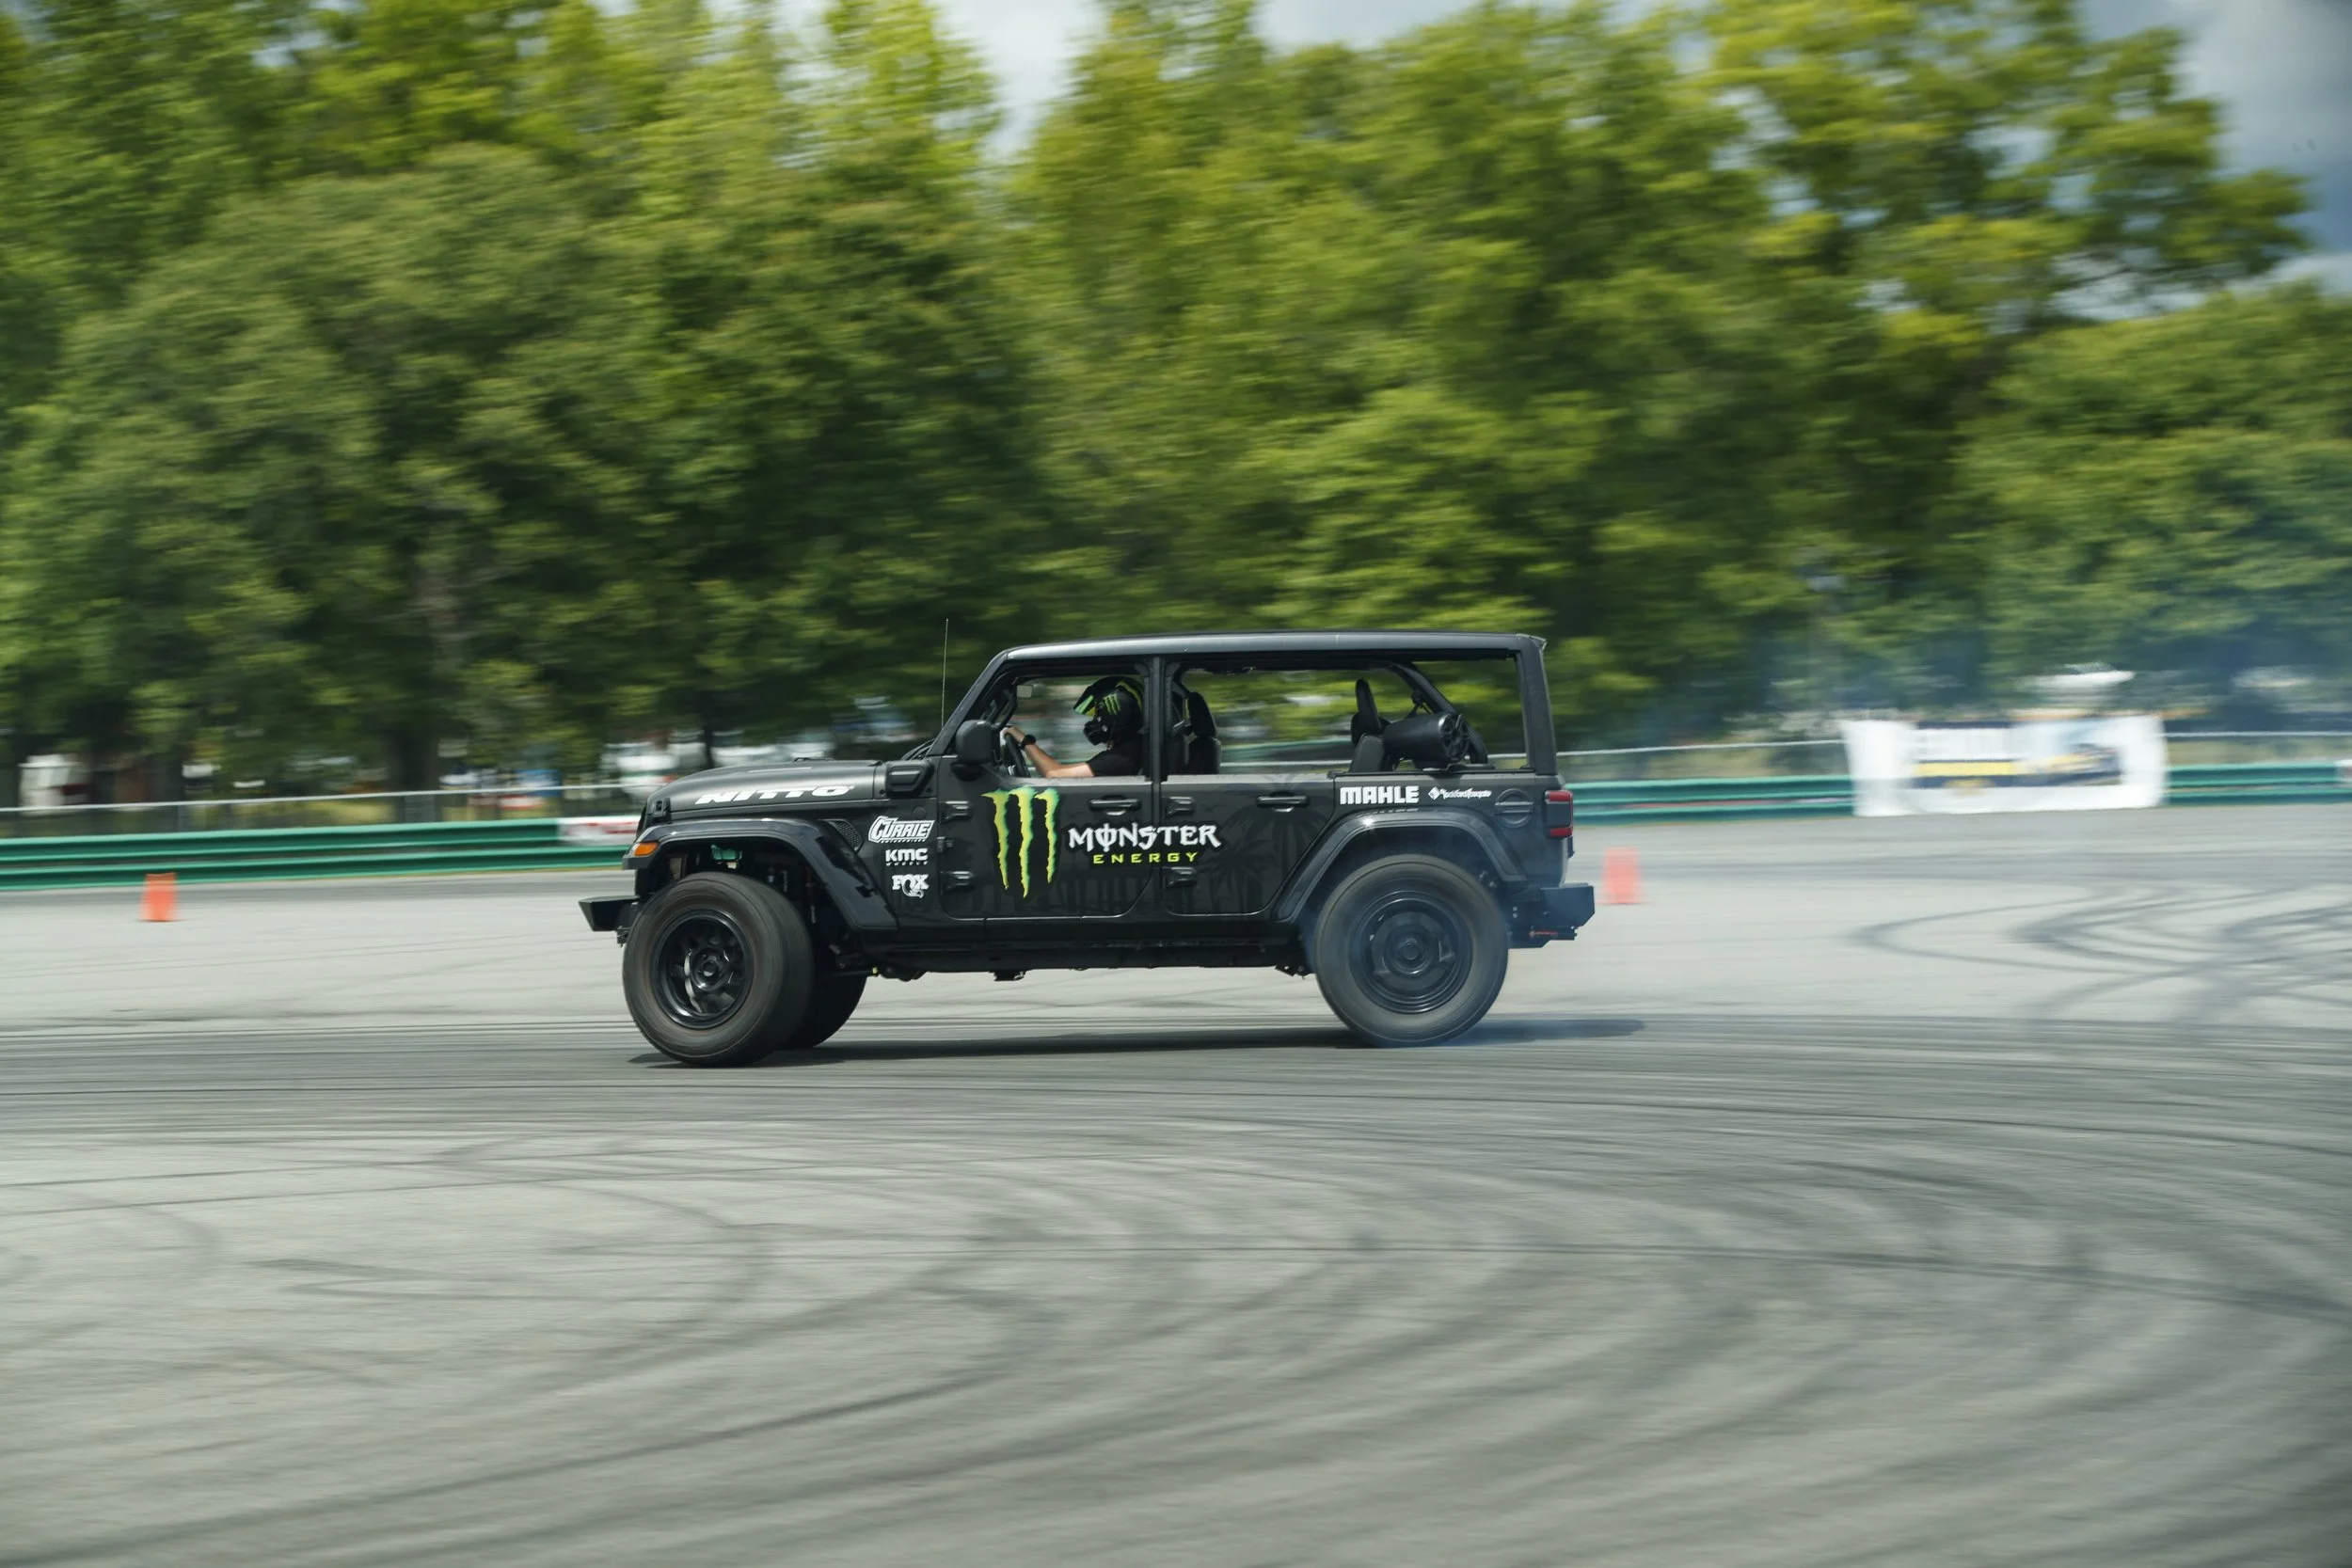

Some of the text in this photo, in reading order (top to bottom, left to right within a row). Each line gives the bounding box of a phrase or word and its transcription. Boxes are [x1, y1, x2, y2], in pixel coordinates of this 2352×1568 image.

[694, 784, 851, 805] NITTO
[1340, 785, 1420, 805] MAHLE
[870, 818, 930, 840] CURRIE
[1068, 822, 1221, 852] MONSTER
[885, 848, 929, 862] KMC
[1093, 852, 1198, 864] ENERGY
[892, 874, 930, 898] FOX
